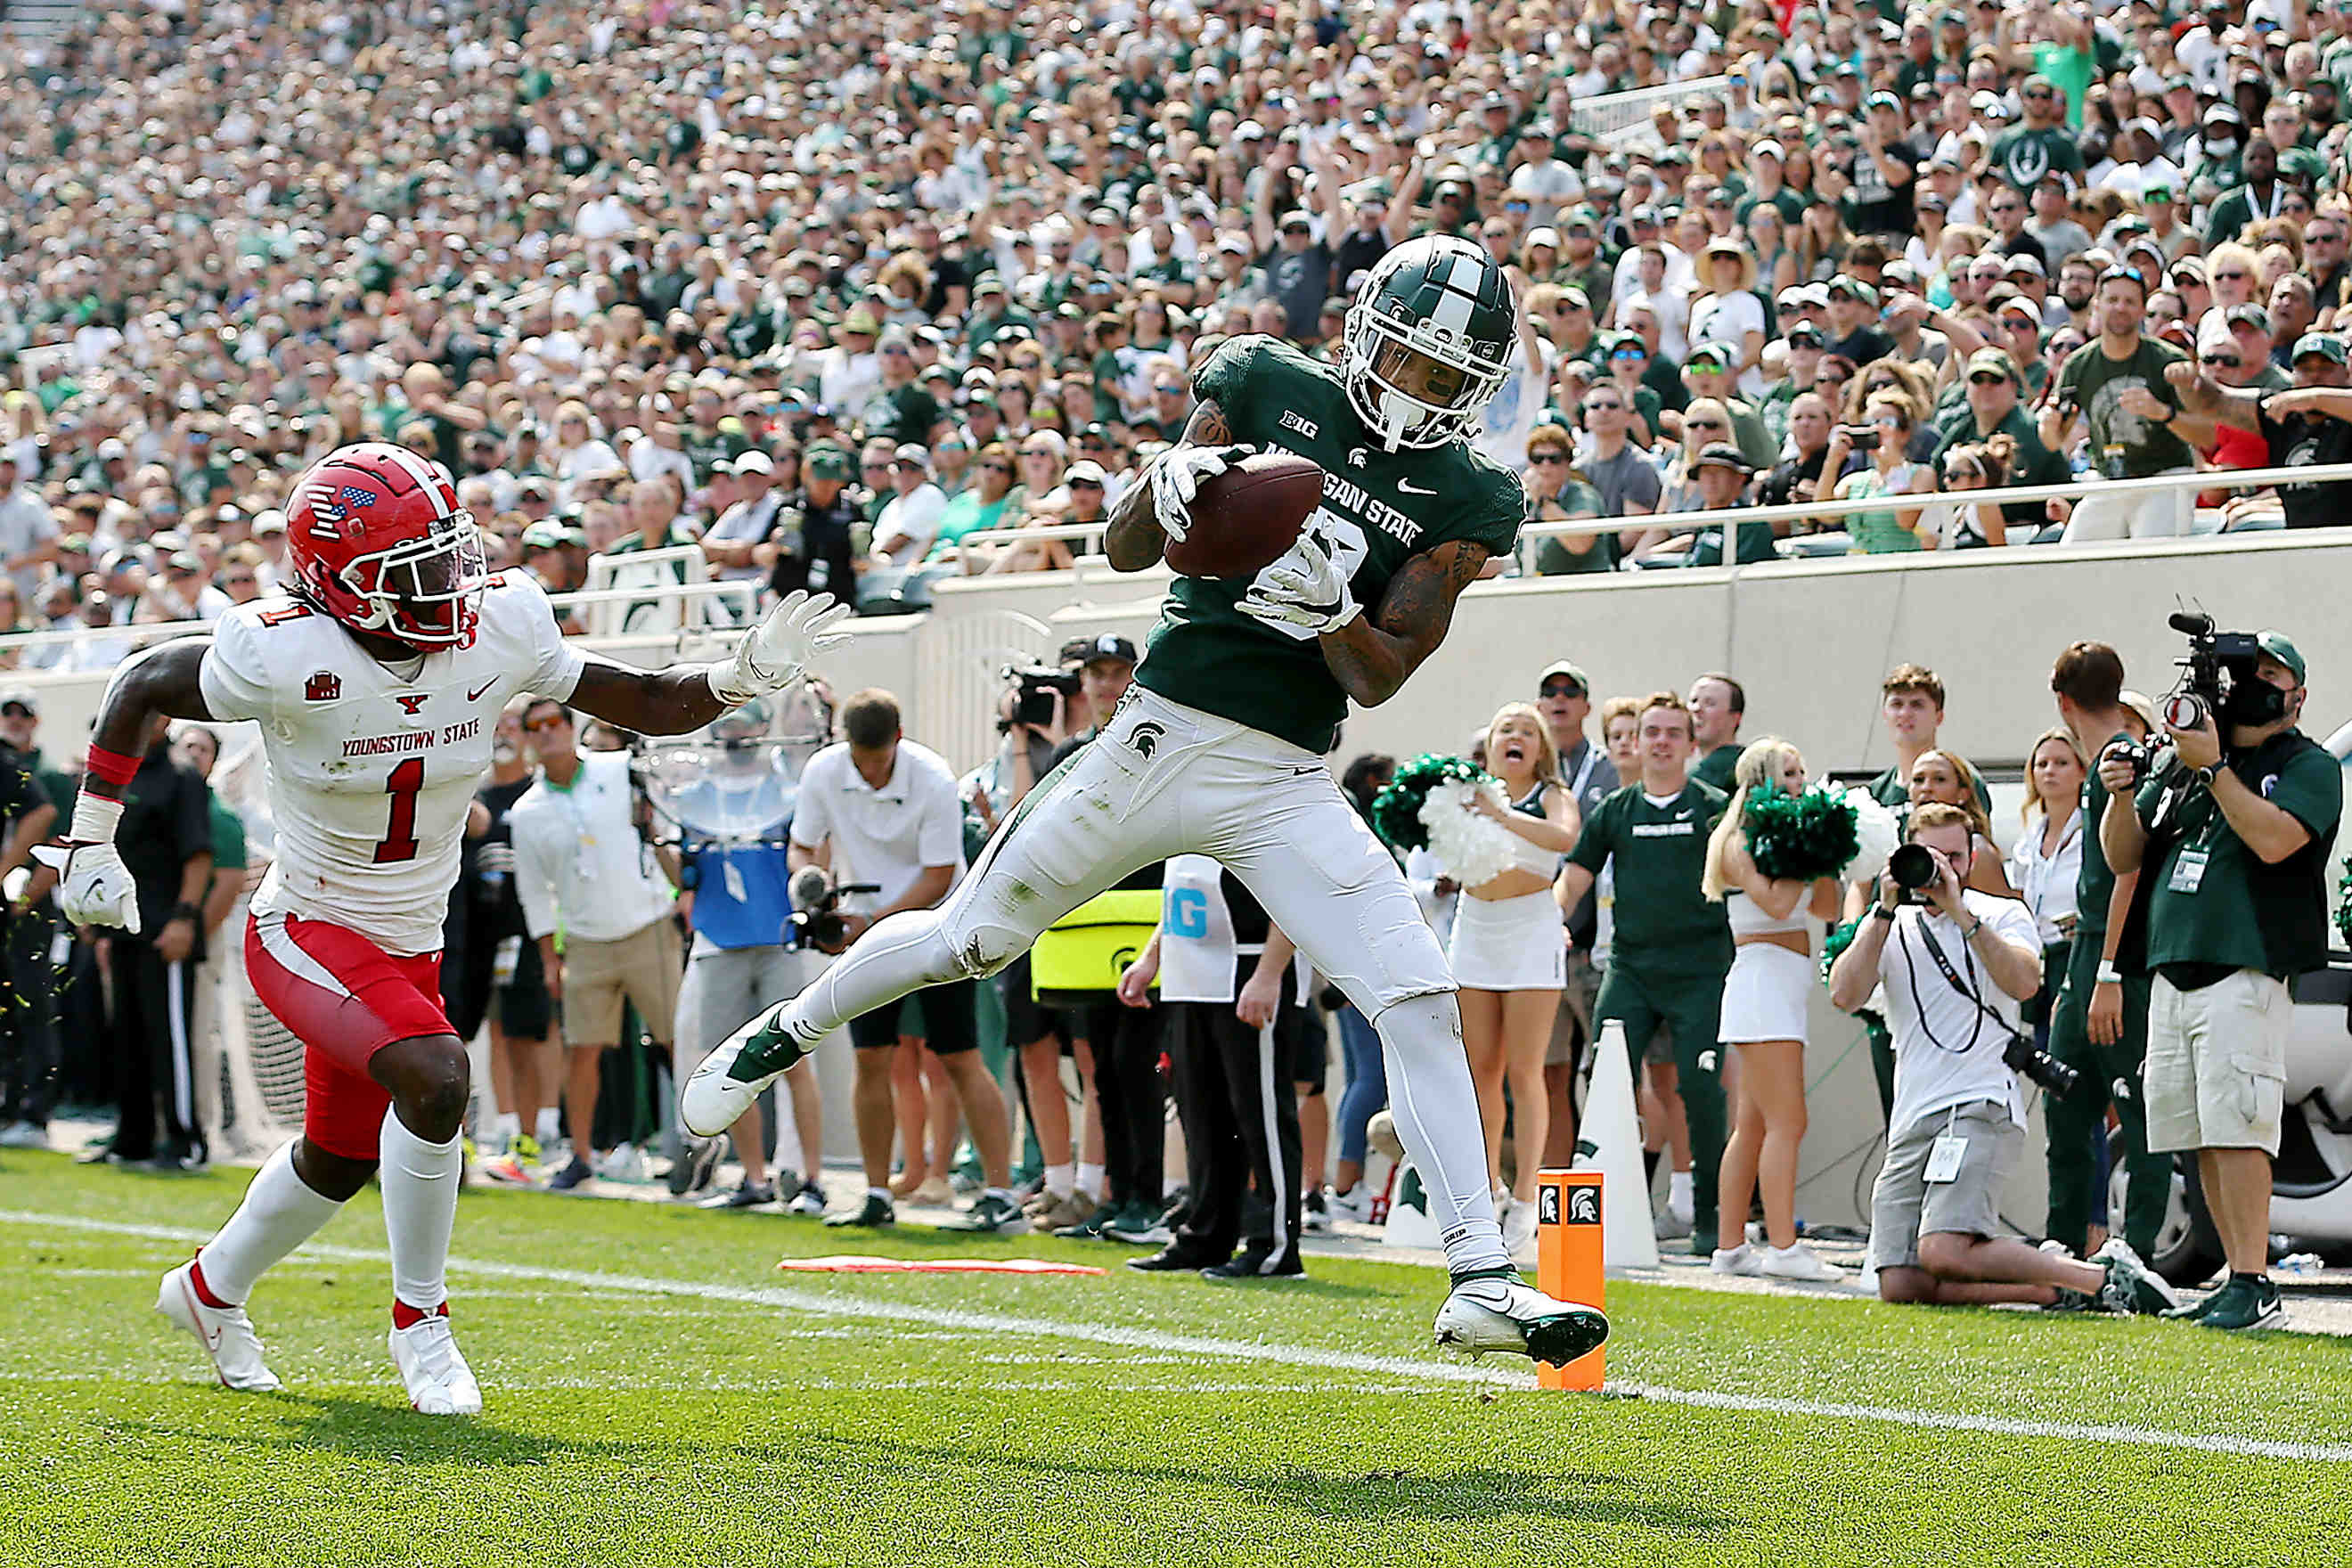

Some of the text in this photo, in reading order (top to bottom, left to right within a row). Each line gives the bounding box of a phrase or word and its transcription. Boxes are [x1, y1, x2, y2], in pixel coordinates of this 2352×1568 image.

[1365, 499, 1425, 548] STATE
[342, 717, 480, 757] YOUNGSTOWN STATE
[371, 755, 426, 864] 1
